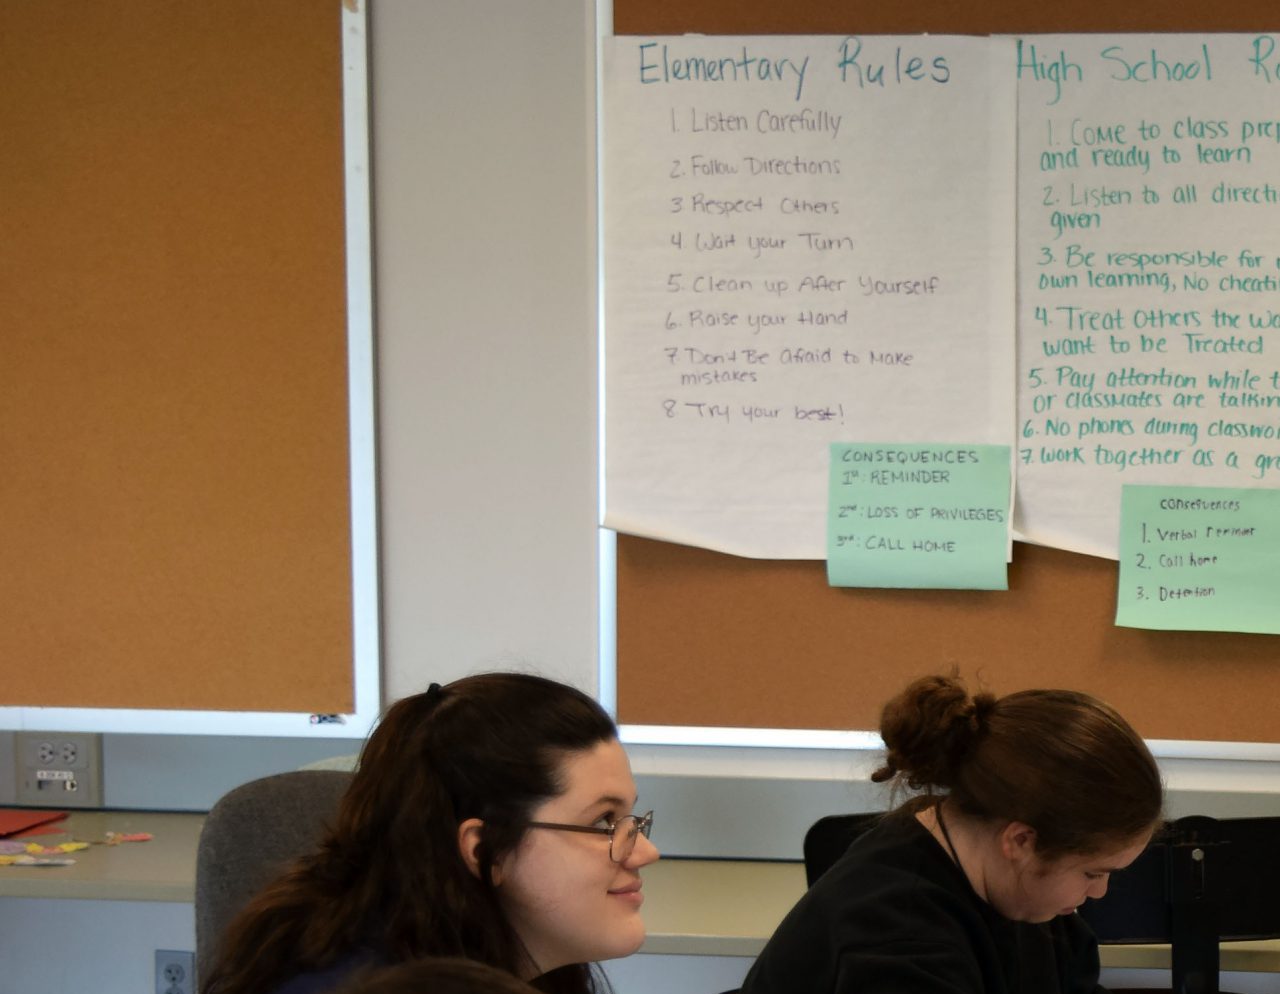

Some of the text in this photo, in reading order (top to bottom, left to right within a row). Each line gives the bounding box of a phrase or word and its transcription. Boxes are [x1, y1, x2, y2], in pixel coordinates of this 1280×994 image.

[640, 36, 950, 101] Elementary Rules
[1016, 39, 1083, 105] High
[1101, 44, 1211, 81] School
[692, 108, 842, 138] Listen Carefully
[1138, 122, 1160, 139] to
[1174, 117, 1228, 139] class
[692, 156, 841, 175] Follow Directions
[1040, 143, 1251, 174] and ready to learn
[1043, 187, 1060, 206] 2.
[1070, 184, 1131, 206] Listen
[1142, 187, 1159, 203] to
[1173, 185, 1196, 203] all
[692, 195, 839, 218] Respect Others
[1051, 212, 1100, 239] given
[696, 232, 853, 258] Wait your Turn
[1038, 247, 1057, 265] 3.
[1066, 245, 1095, 267] Be
[1107, 251, 1227, 276] responsible
[1238, 250, 1262, 267] for
[692, 275, 753, 292] Clean
[765, 280, 787, 298] up
[800, 277, 846, 292] After
[1038, 272, 1078, 288] own
[1088, 270, 1177, 292] learning,
[1184, 274, 1209, 291] No
[690, 310, 848, 333] Raise your Hand
[1034, 307, 1052, 325] 4.
[1056, 307, 1123, 330] Treat
[1213, 309, 1240, 329] the
[1043, 334, 1263, 356] want to be Treated
[743, 349, 768, 364] Be
[844, 351, 859, 364] to
[870, 351, 913, 366] Make
[681, 369, 757, 385] mistakes
[1029, 368, 1047, 388] 5.
[1056, 366, 1095, 392] Pay
[1106, 368, 1196, 387] attention
[1208, 370, 1260, 390] while
[1034, 395, 1057, 413] or
[1066, 391, 1161, 408] classmates
[1173, 394, 1204, 407] are
[685, 403, 844, 425] Try your best!
[1023, 422, 1039, 437] 6.
[1046, 419, 1070, 435] No
[1078, 419, 1134, 437] phones
[1144, 418, 1198, 445] during
[842, 449, 980, 465] CONSEQUENCES
[1095, 447, 1183, 472] together
[1193, 450, 1214, 466] as
[1226, 451, 1239, 467] a
[870, 470, 950, 483] REMINDER
[867, 507, 898, 518] LOSS
[906, 508, 921, 519] OF
[930, 508, 1003, 521] PRIVILEGES
[865, 537, 904, 550] CALL
[913, 541, 955, 552] HOME
[1137, 554, 1151, 569] 2.
[1137, 586, 1215, 601] 3. Detention
